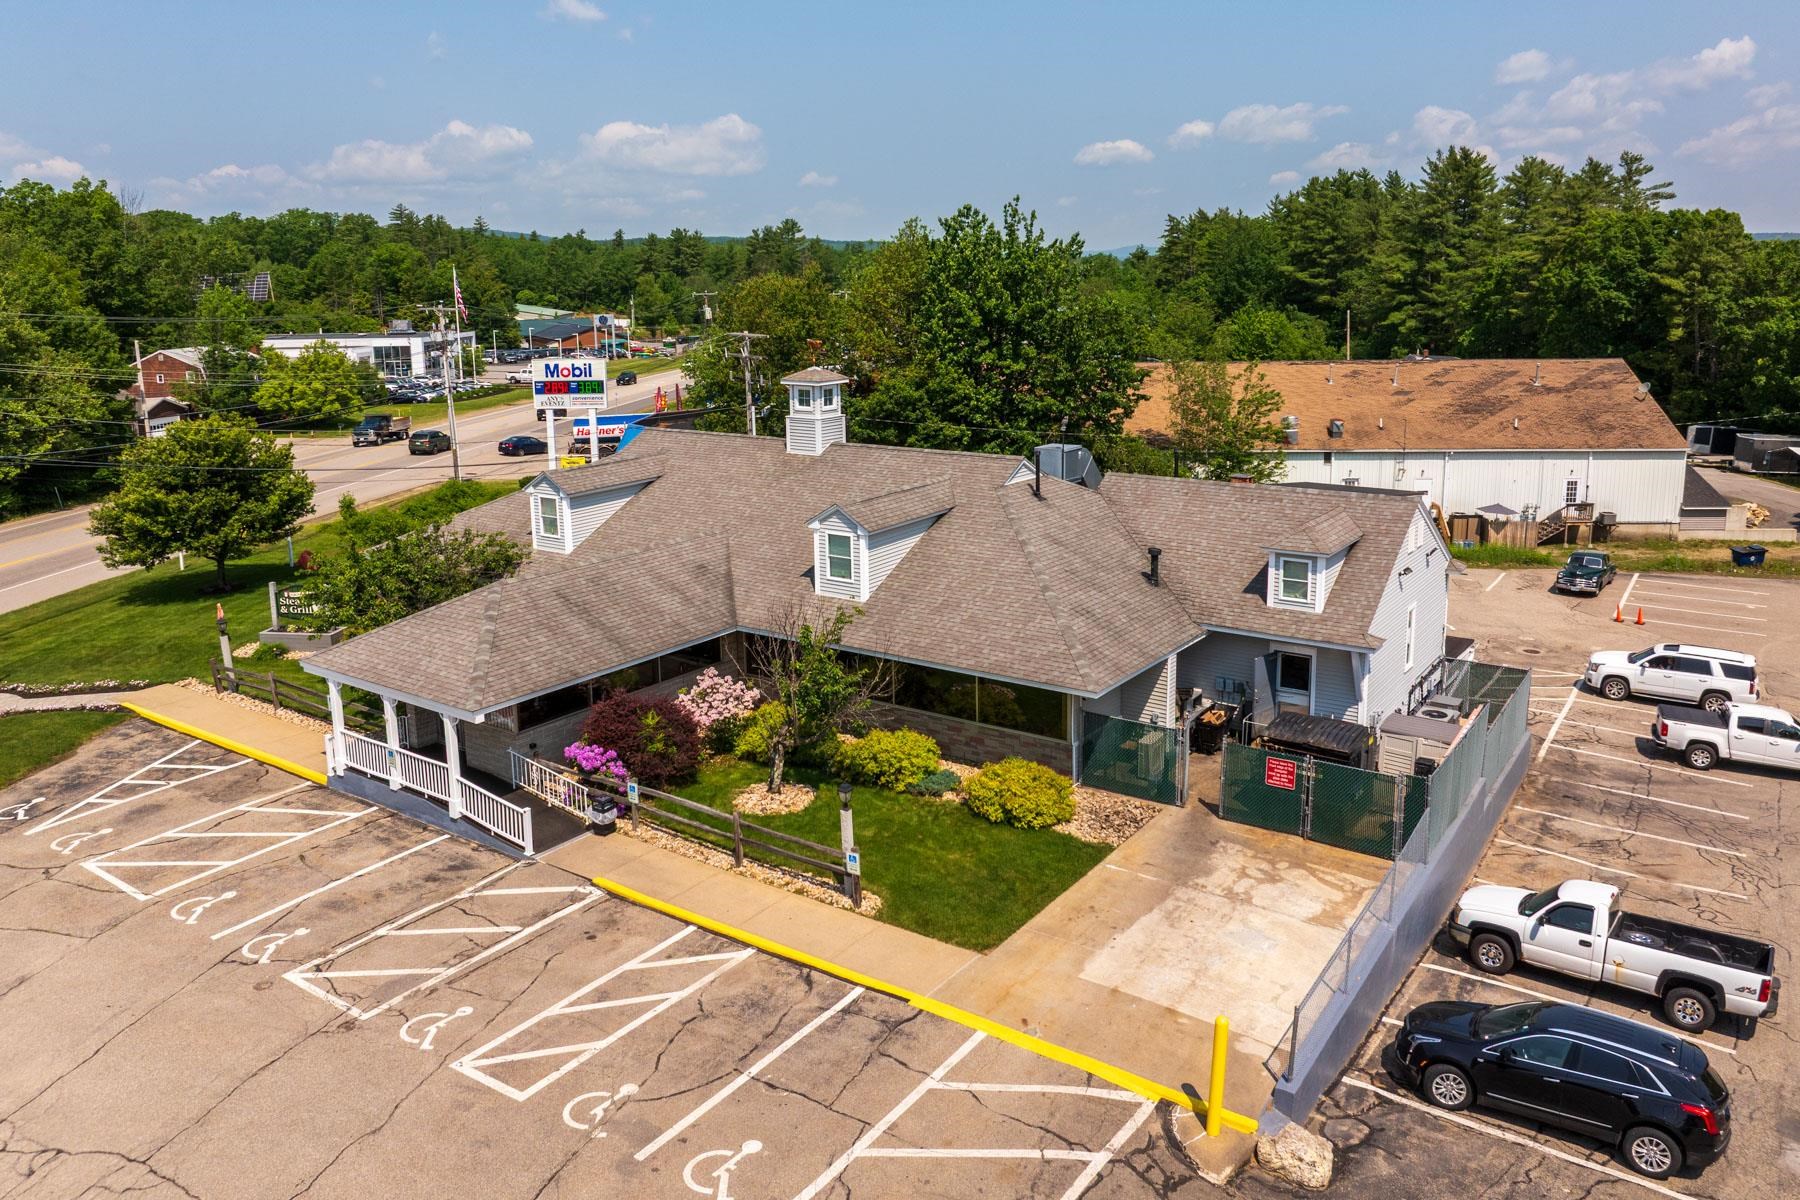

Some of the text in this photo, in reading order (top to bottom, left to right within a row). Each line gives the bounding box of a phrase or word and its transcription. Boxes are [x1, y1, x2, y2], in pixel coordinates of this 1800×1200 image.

[544, 363, 592, 378] Mobil
[576, 426, 624, 436] Haner's
[280, 606, 288, 614] &
